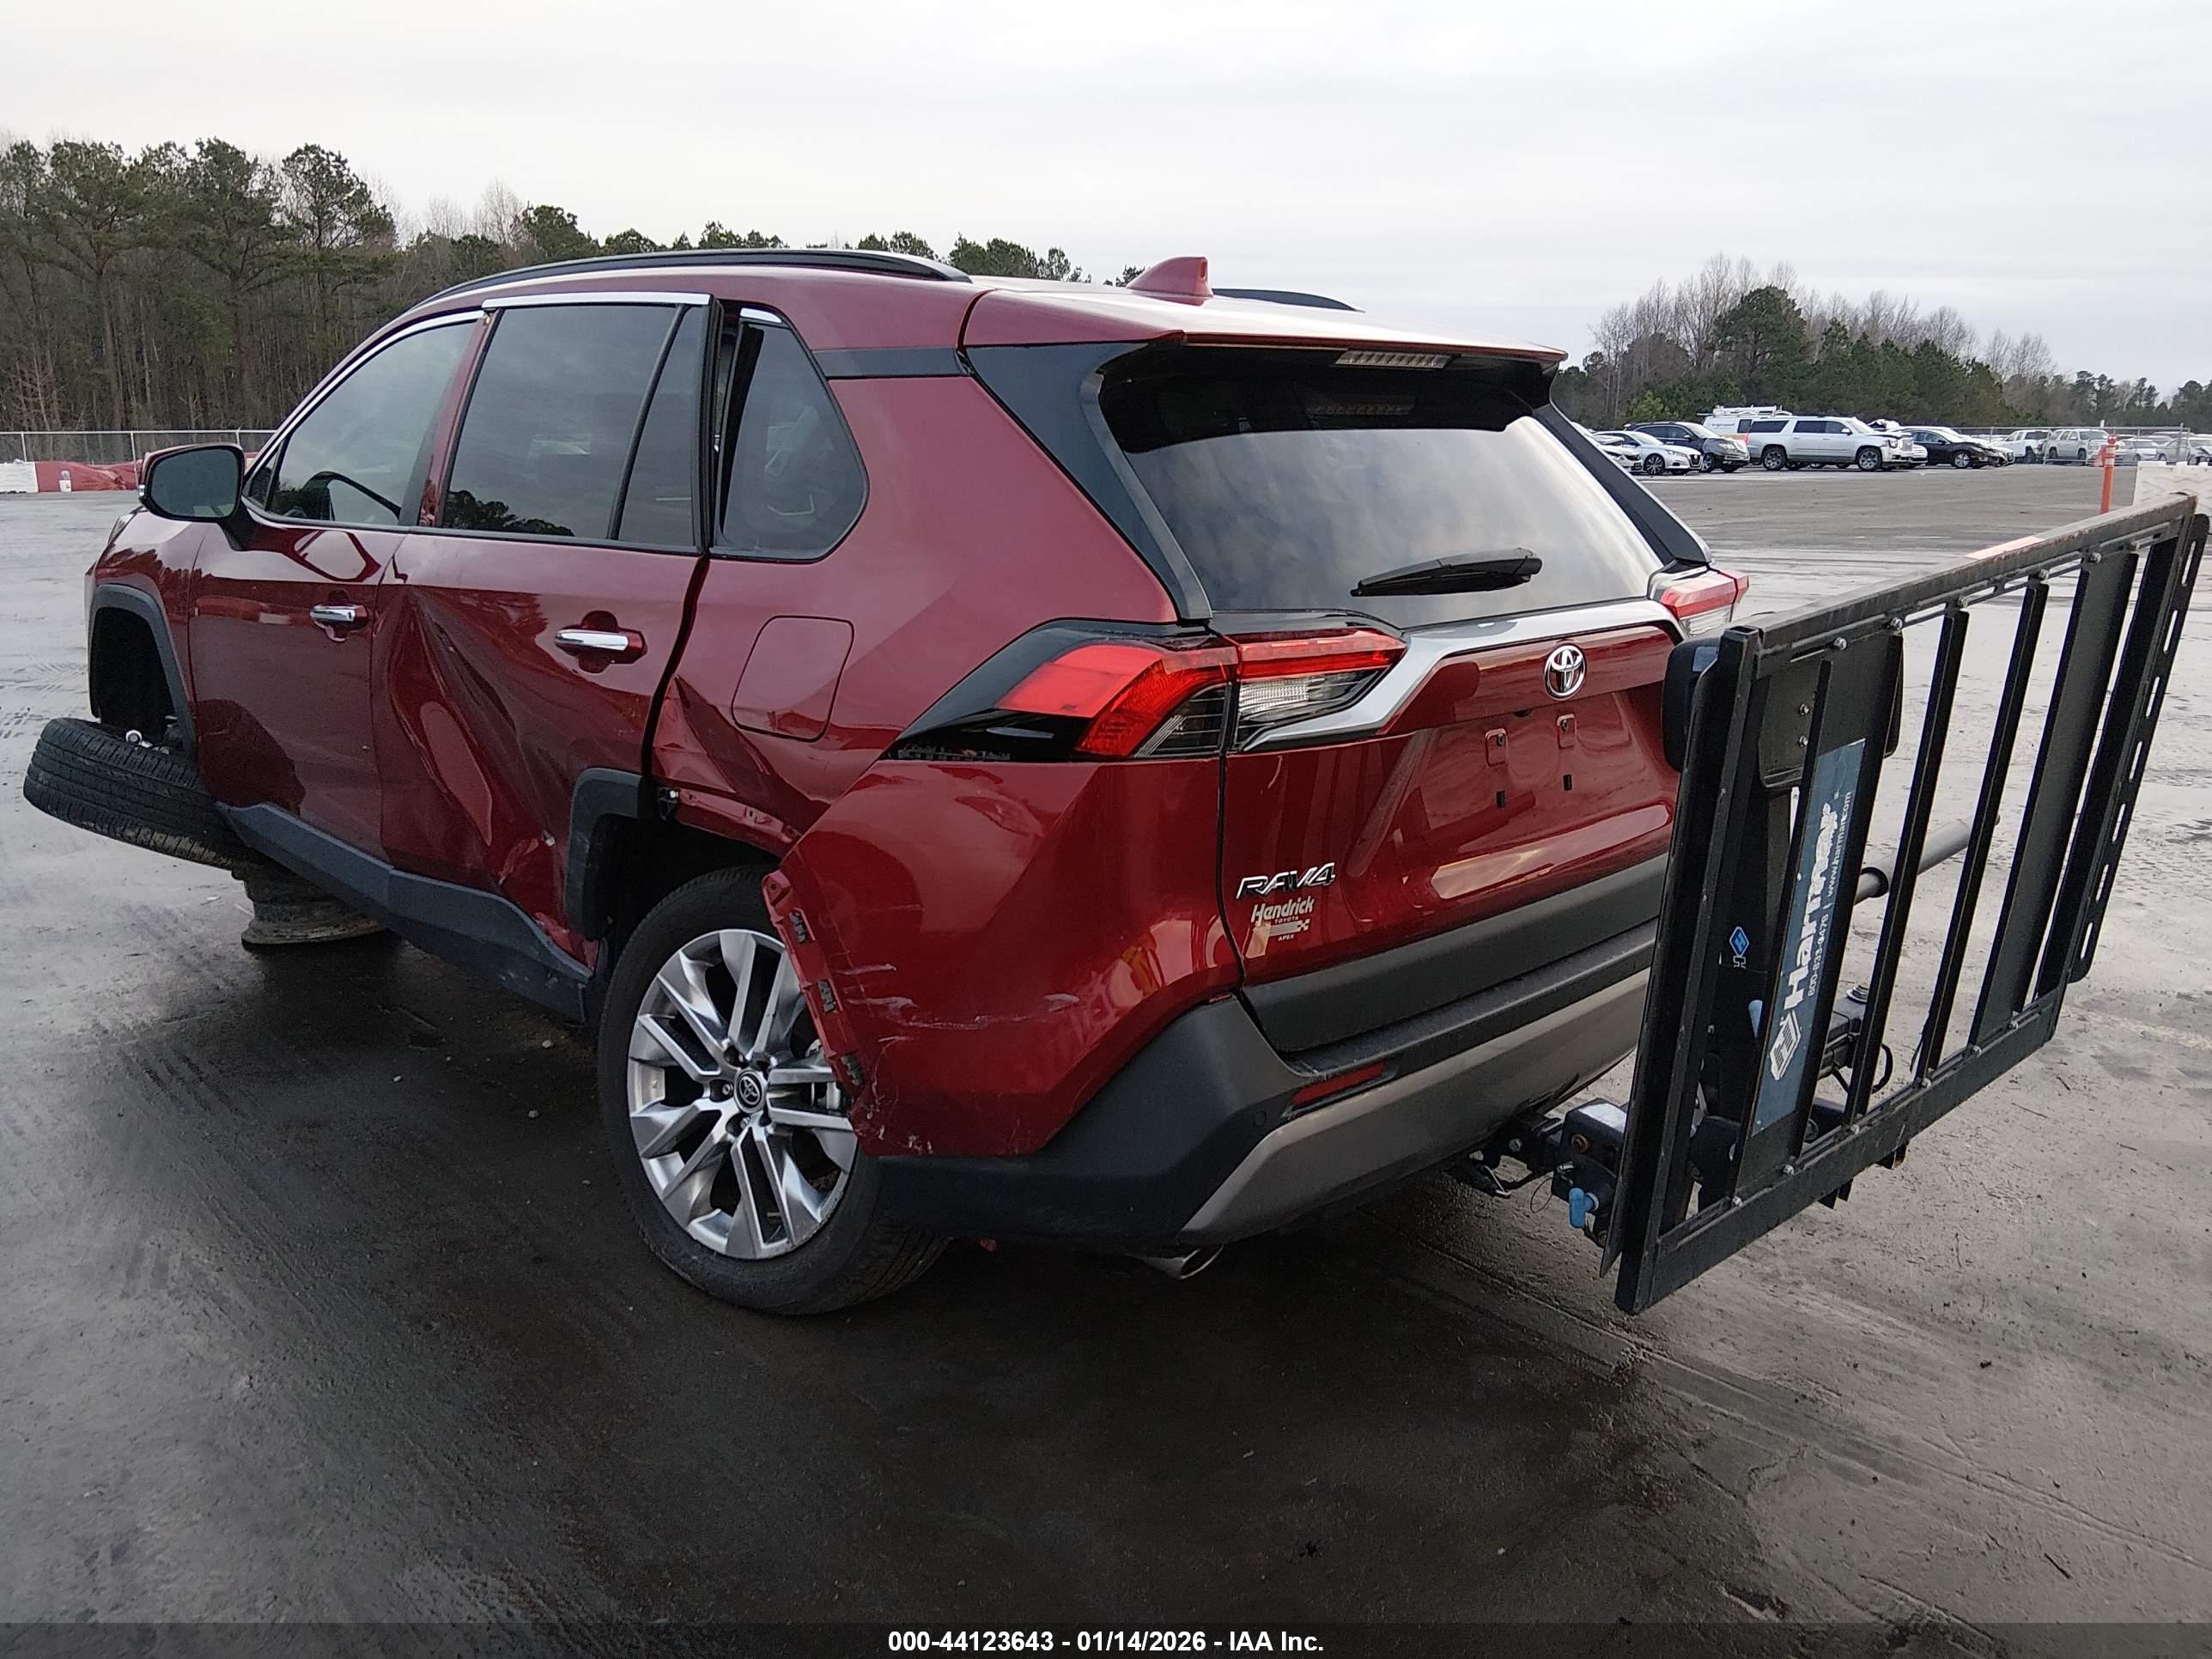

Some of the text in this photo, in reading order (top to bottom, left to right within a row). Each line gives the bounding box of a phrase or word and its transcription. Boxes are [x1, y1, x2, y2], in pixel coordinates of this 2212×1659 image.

[1236, 862, 1335, 899] RAV4
[1250, 896, 1315, 927] Hendrick
[1274, 915, 1298, 924] TOYOTA
[1784, 802, 1838, 1010] Harmar
